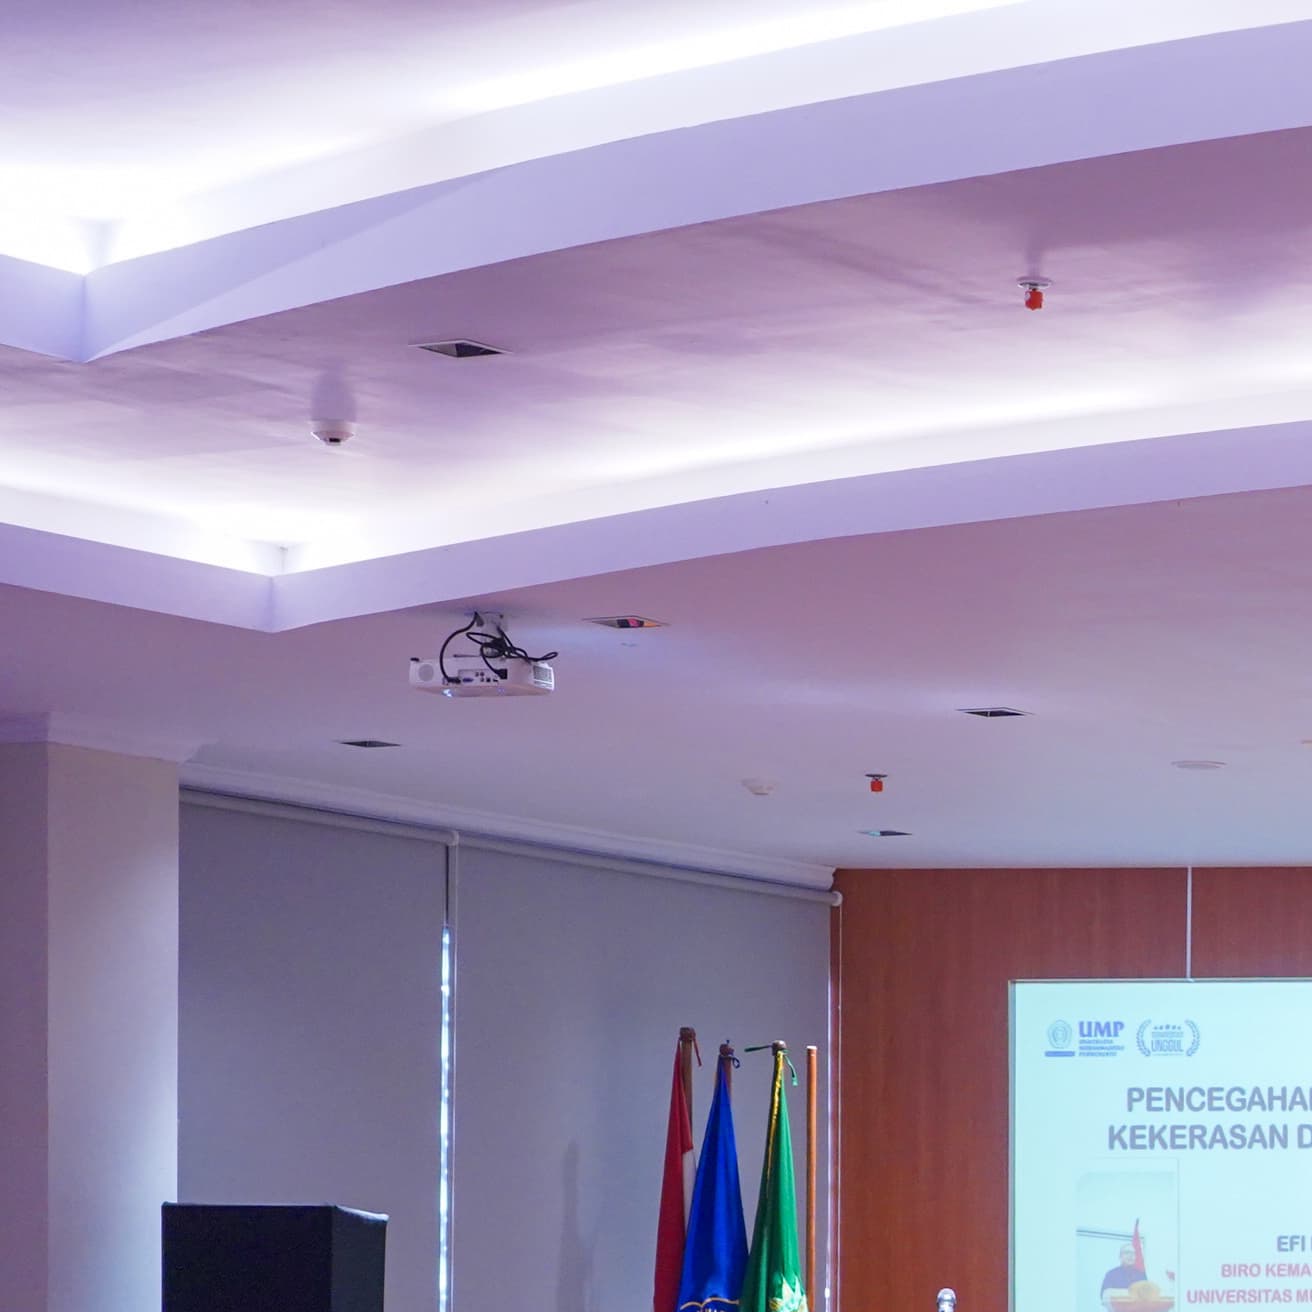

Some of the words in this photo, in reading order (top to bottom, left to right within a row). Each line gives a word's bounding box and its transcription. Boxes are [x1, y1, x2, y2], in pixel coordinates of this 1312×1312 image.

[1079, 1021, 1124, 1038] UMP
[1108, 1124, 1288, 1150] KEKERASAN
[1276, 1236, 1306, 1252] EFI
[1221, 1264, 1261, 1278] BIRO
[1187, 1288, 1292, 1304] UNIVERSITAS
